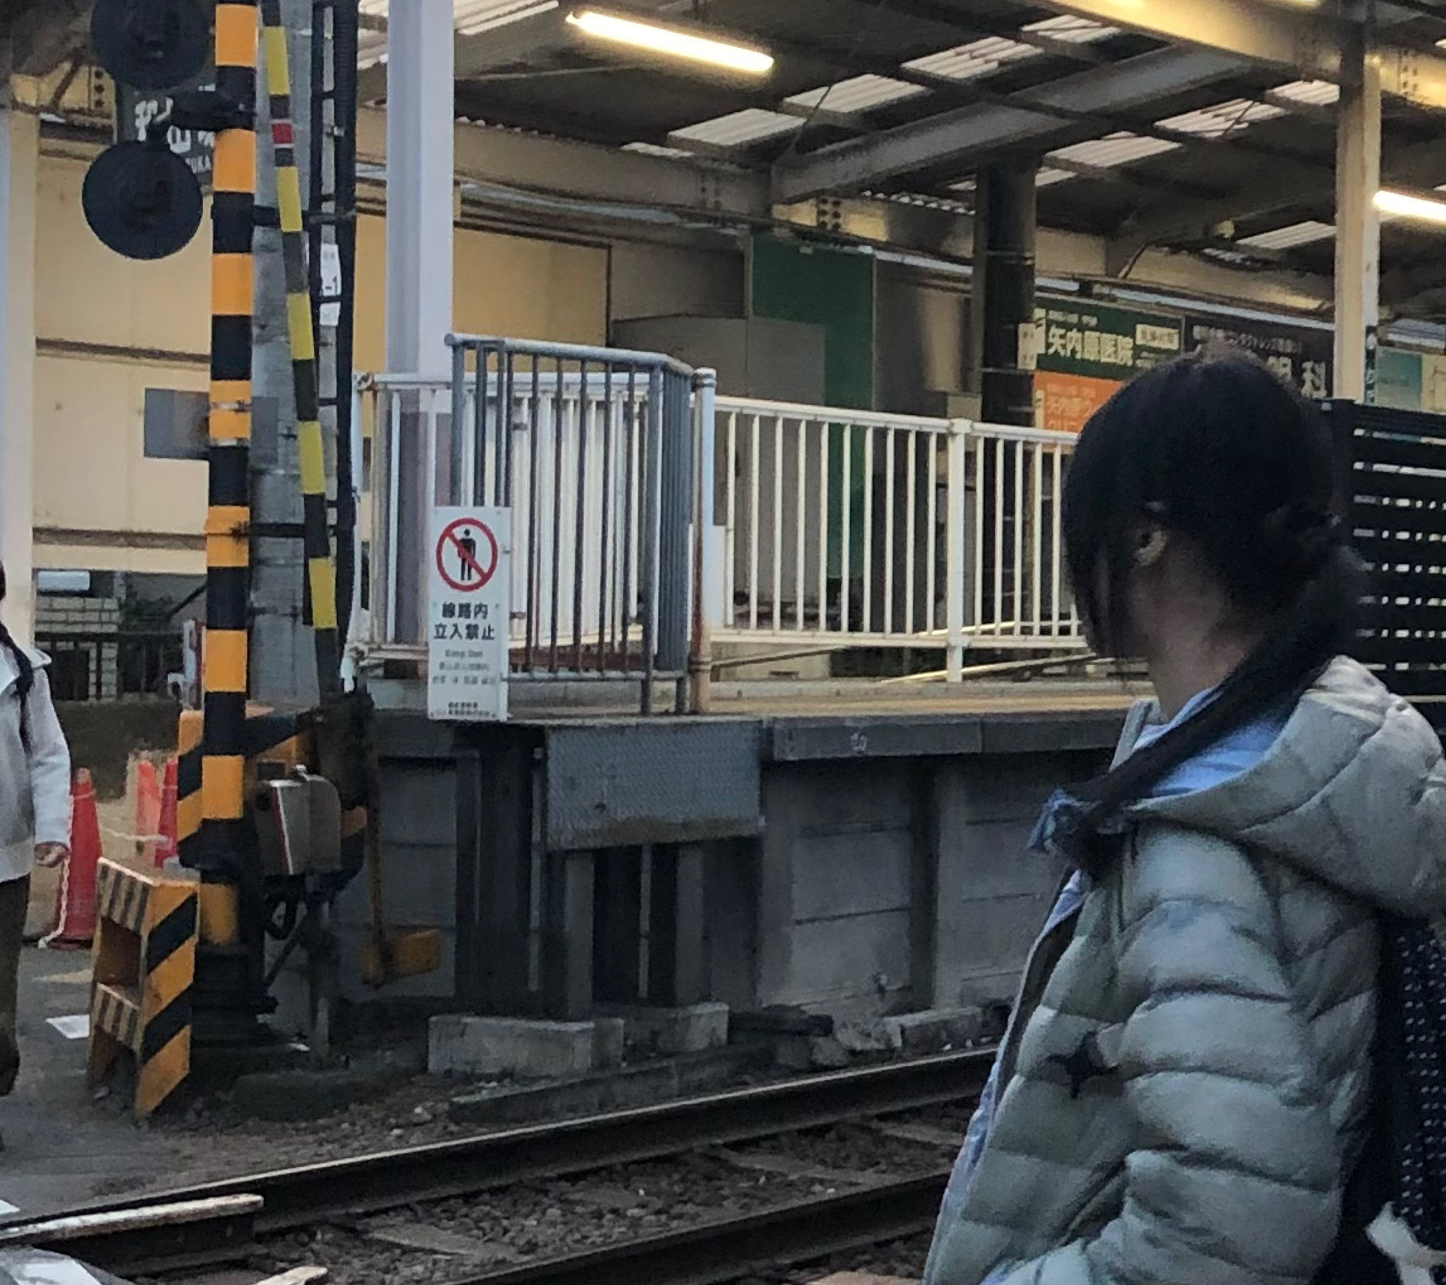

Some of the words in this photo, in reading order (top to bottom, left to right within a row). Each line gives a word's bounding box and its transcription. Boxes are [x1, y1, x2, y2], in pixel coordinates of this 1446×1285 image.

[442, 602, 489, 620] 線路内
[433, 622, 495, 640] 立入禁止
